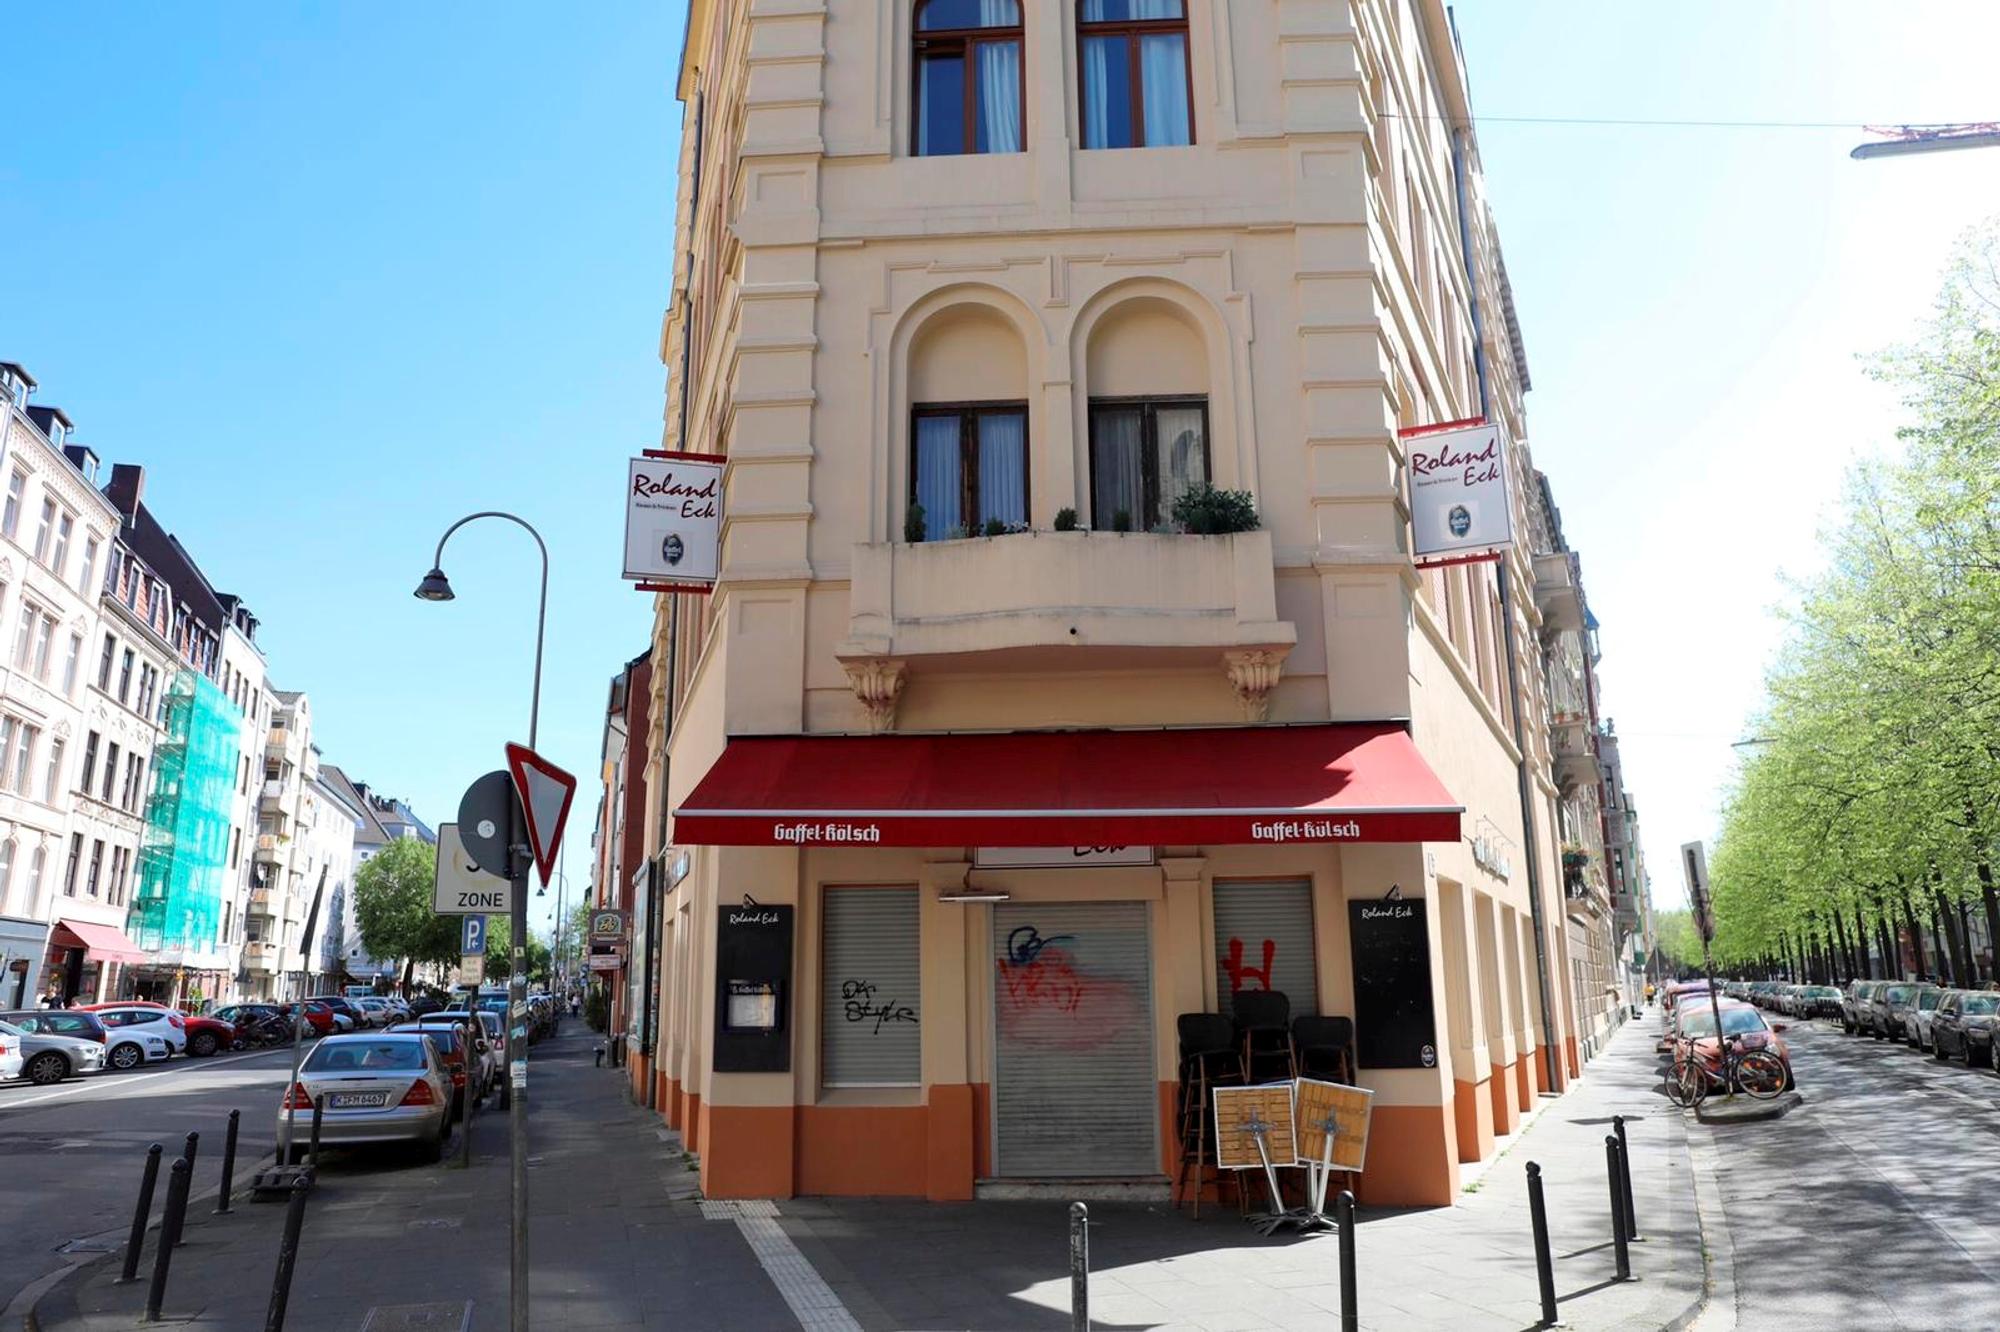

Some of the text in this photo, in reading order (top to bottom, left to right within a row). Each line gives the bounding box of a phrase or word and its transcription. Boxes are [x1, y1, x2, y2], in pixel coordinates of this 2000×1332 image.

[1411, 437, 1498, 477] Roland
[633, 472, 717, 498] Roland
[1463, 462, 1500, 487] Eck
[681, 500, 716, 519] Eck
[774, 823, 880, 844] Gaffel-Kölsch
[1252, 820, 1360, 842] Gaffel-Kölsch
[458, 892, 504, 907] ZONE
[729, 912, 779, 925] Roland Eck
[1361, 906, 1413, 919] Roland Eck
[467, 920, 480, 950] P
